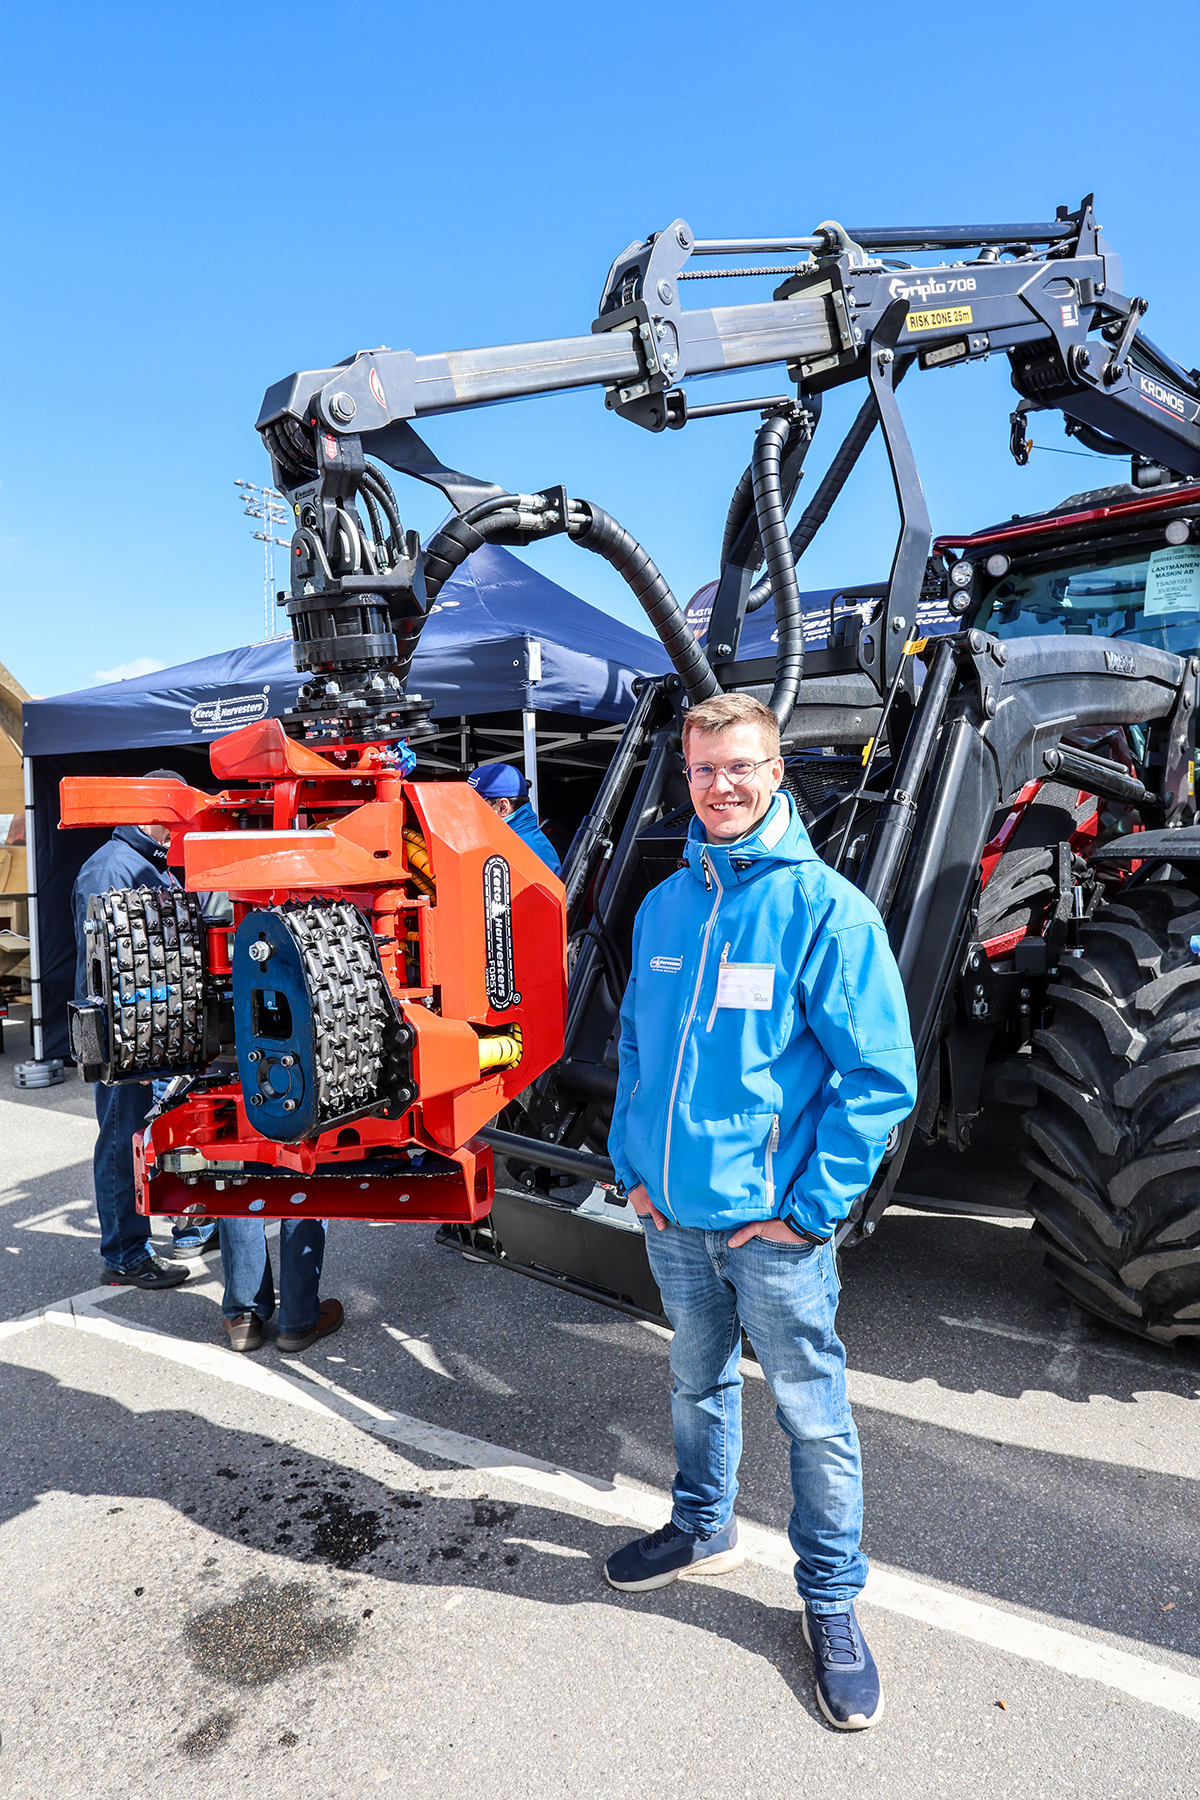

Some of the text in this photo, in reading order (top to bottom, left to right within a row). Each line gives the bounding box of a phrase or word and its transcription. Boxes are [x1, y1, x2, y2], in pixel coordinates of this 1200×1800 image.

[947, 278, 977, 293] 708
[909, 310, 970, 329] RISK ZONE 25m
[1140, 376, 1185, 414] KRONOS
[1155, 570, 1182, 578] MASKIN
[1157, 585, 1188, 595] SVERIGE
[195, 703, 263, 719] Keto Harvesters
[493, 868, 505, 997] Keto Harvesters
[488, 959, 497, 995] FORST
